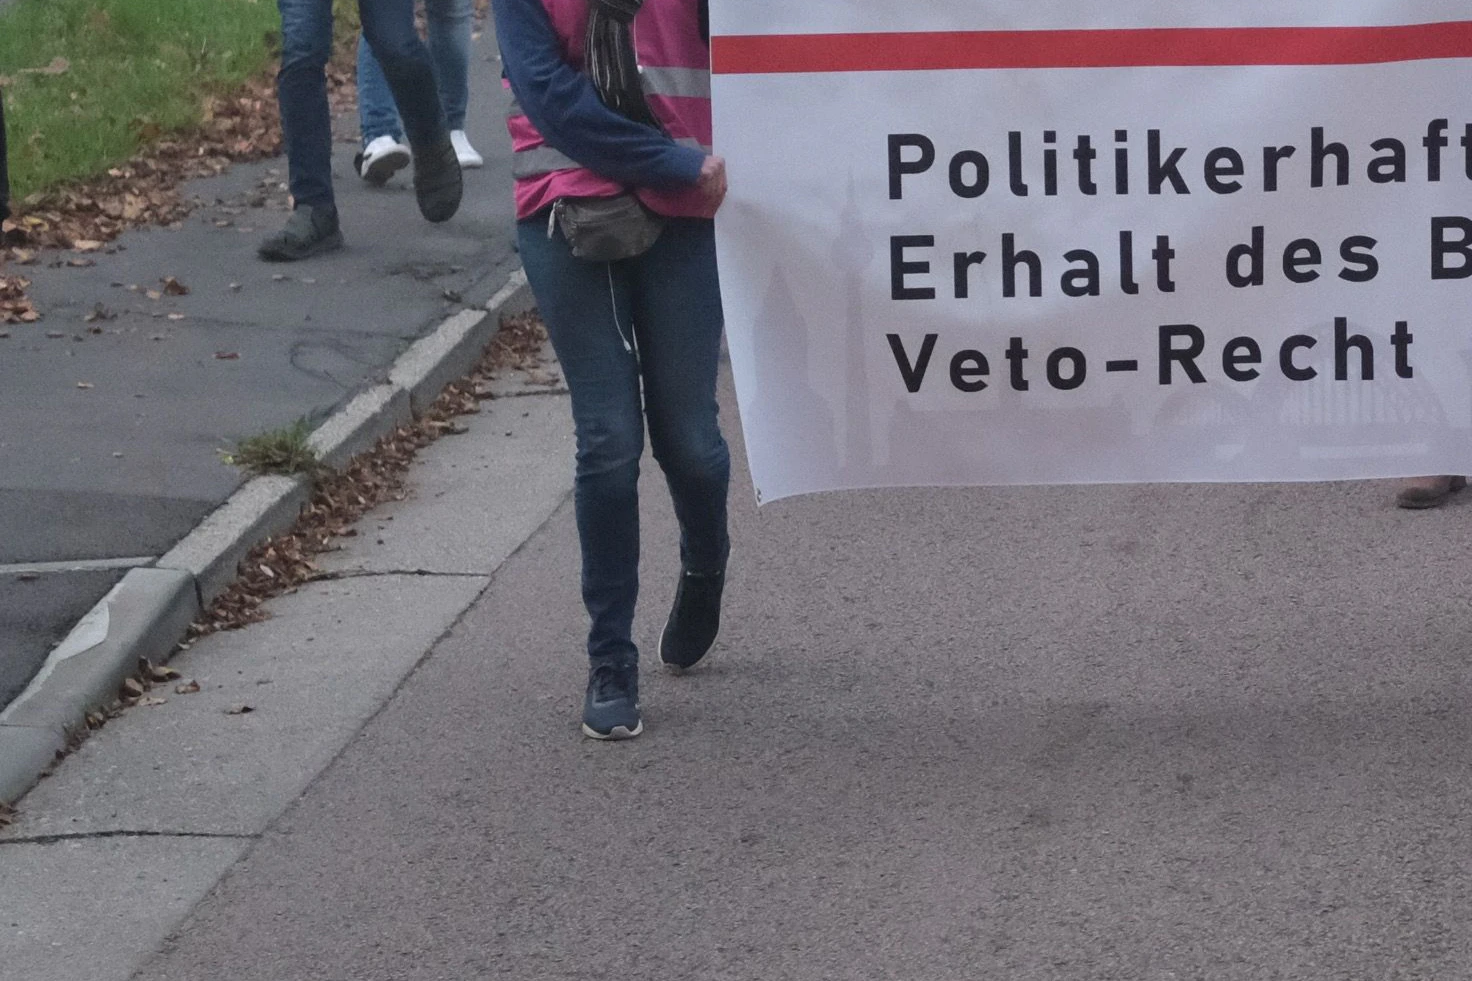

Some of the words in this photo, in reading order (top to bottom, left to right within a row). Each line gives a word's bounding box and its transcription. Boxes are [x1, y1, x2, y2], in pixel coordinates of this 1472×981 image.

[890, 230, 1176, 301] Erhalt
[1225, 225, 1379, 288] des
[885, 316, 1414, 394] Veto-Recht
